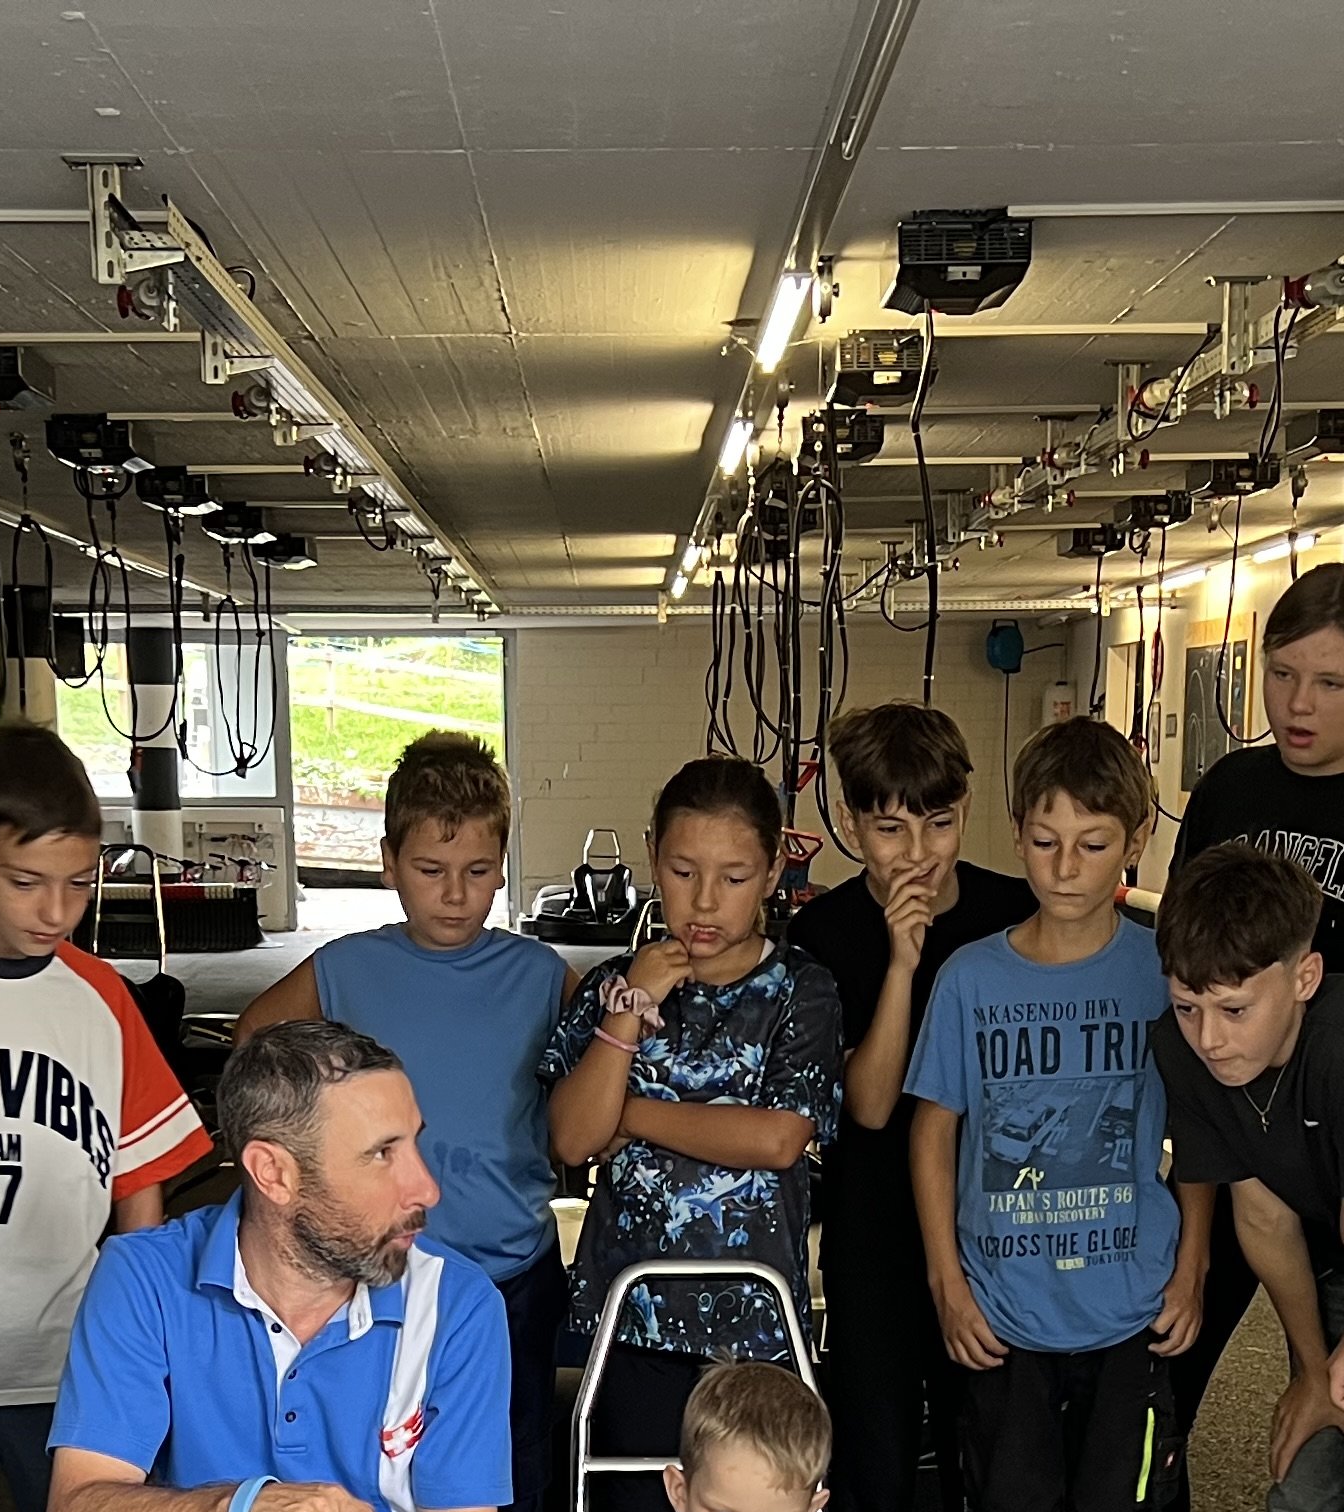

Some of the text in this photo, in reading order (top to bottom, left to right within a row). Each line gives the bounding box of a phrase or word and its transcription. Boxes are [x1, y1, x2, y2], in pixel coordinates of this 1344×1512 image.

[1084, 998, 1122, 1019] HWY
[1058, 1186, 1109, 1209] ROUTE
[1113, 1186, 1133, 1204] 66
[1046, 1206, 1106, 1224] DISCOVERY
[1046, 1232, 1079, 1257] THE
